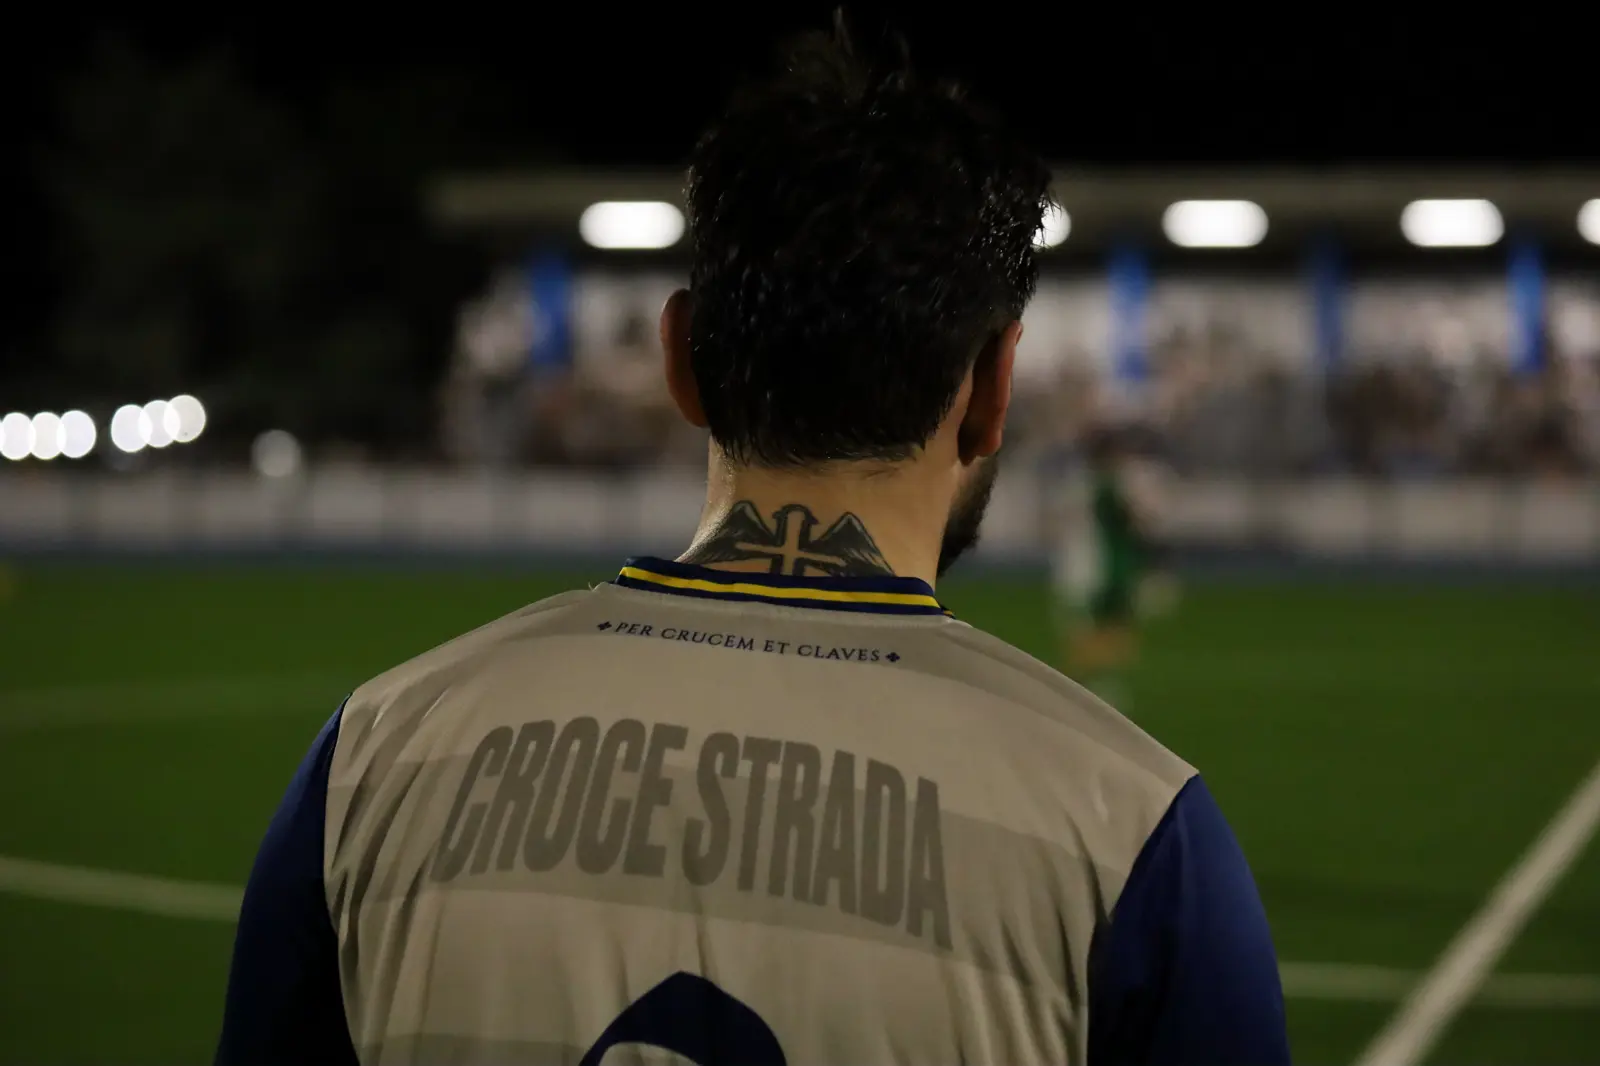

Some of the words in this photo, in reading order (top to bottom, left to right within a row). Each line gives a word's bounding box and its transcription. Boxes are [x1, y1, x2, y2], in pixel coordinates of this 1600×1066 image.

[615, 622, 653, 636] PER
[661, 628, 755, 651] CRUCEM
[763, 639, 790, 655] ET
[797, 645, 880, 661] CLAVES
[430, 717, 688, 882] CROCE
[682, 732, 953, 951] STRADA
